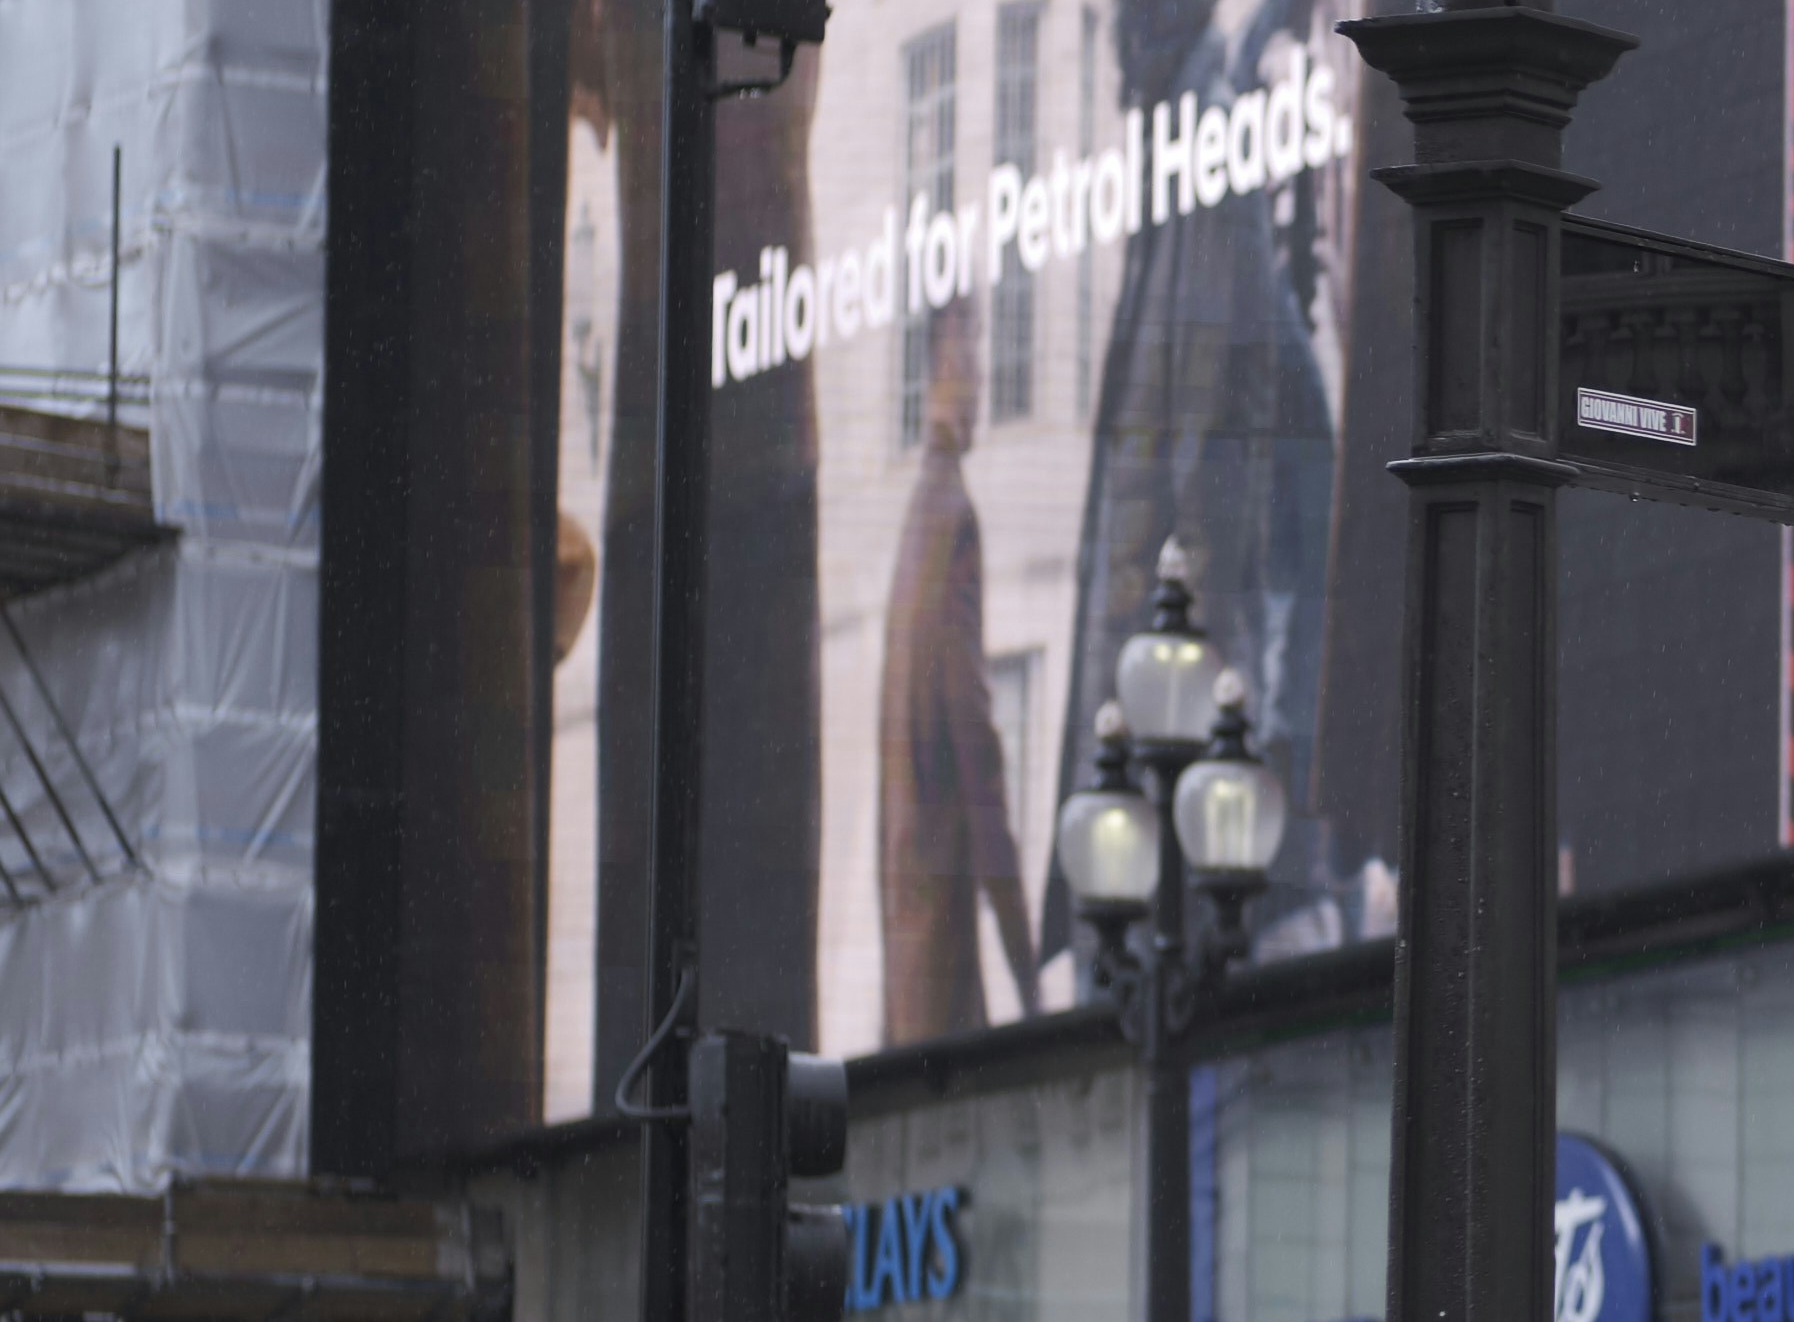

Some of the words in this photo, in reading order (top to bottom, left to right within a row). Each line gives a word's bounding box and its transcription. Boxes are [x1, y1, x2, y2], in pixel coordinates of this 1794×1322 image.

[711, 204, 897, 389] Tailored
[903, 191, 979, 313] for
[989, 107, 1145, 285] Petrol
[1152, 45, 1355, 226] Heads.
[1580, 395, 1638, 428] GIOVANNI
[1639, 406, 1667, 432] VIVE
[843, 1185, 958, 1311] LAYS
